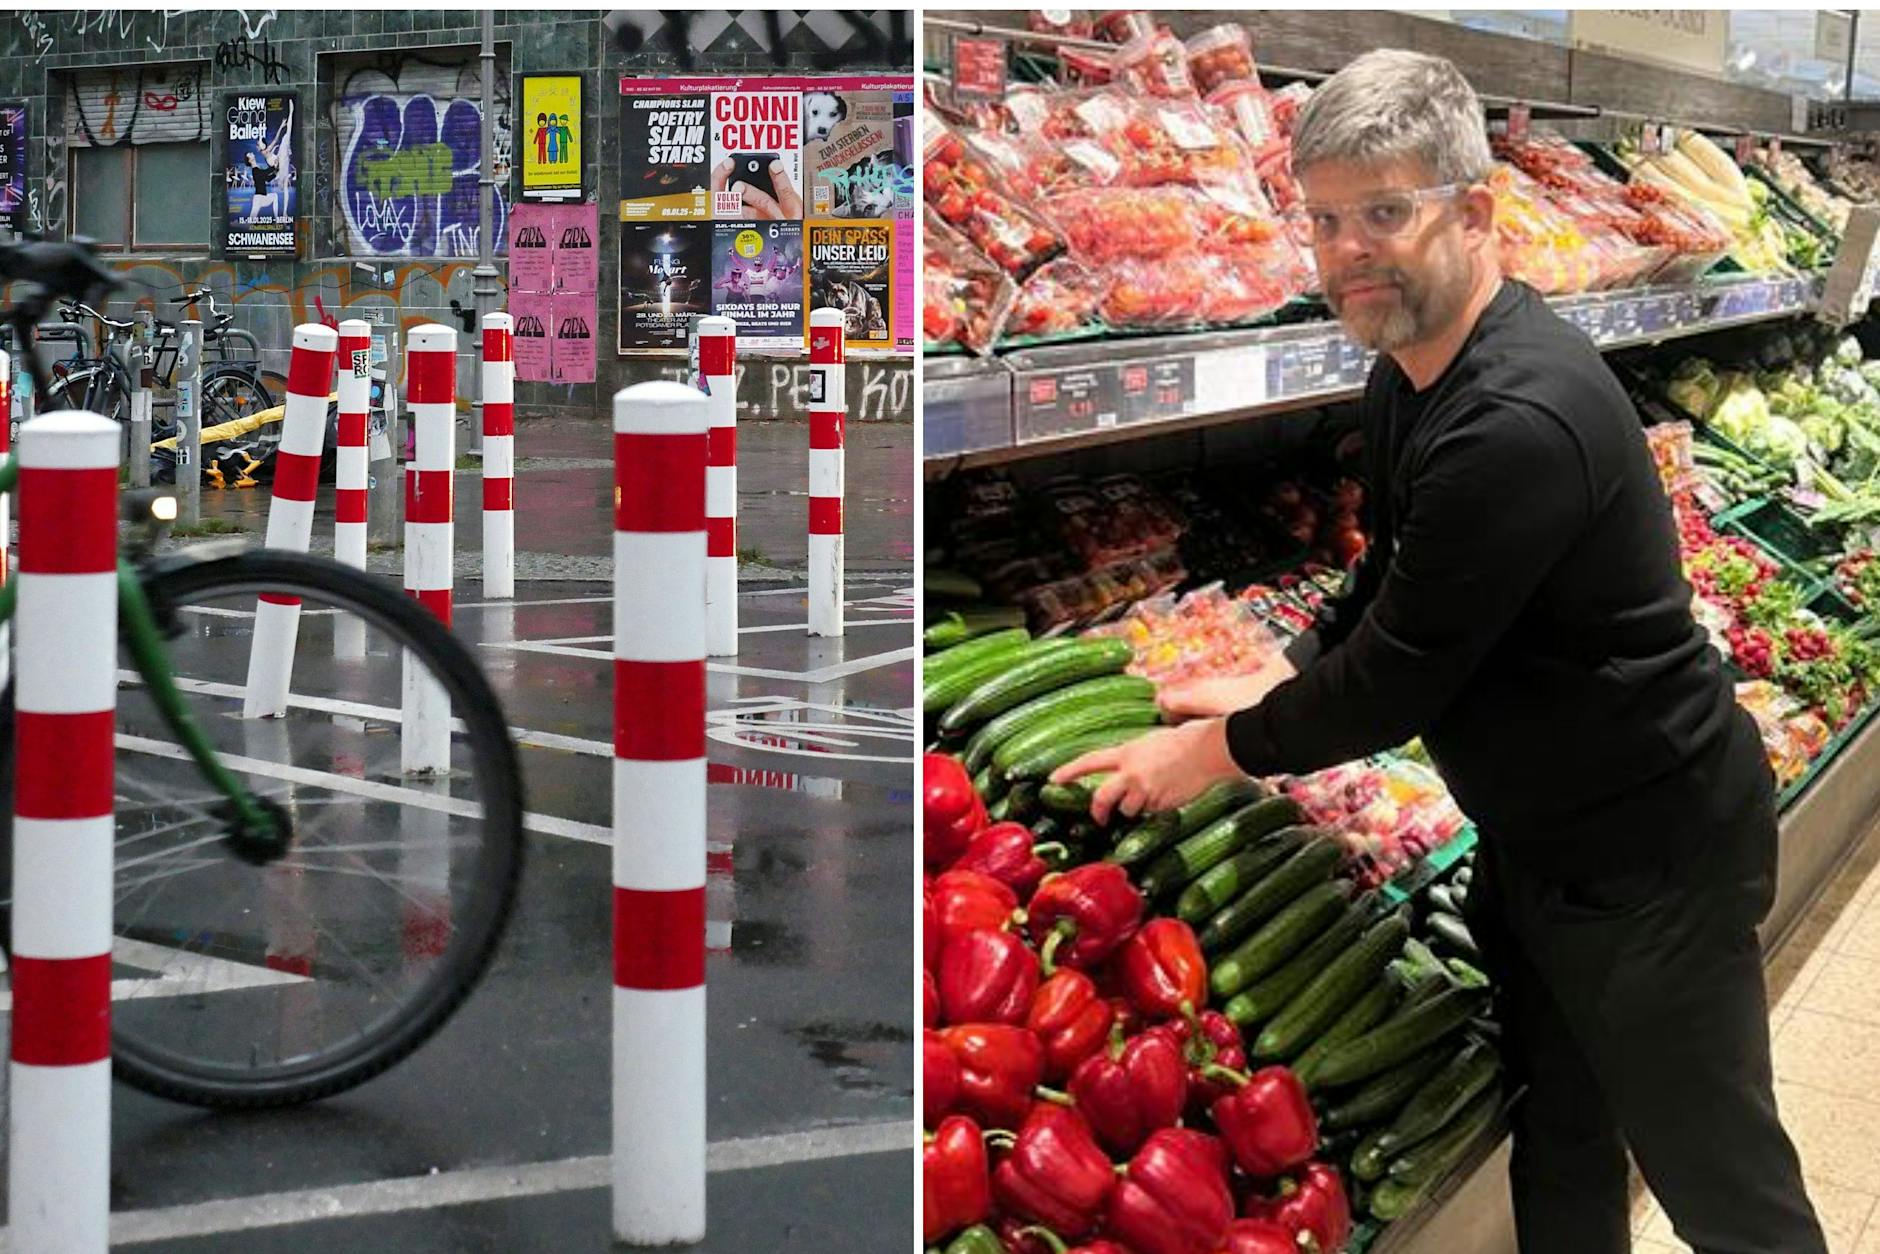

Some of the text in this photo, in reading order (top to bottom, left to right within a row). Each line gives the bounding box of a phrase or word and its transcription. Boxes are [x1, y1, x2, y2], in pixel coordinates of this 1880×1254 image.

[680, 83, 738, 92] Kulturplakatierung
[238, 97, 266, 110] Kiew
[633, 99, 706, 109] CHAMPIONS SLAM
[715, 95, 798, 122] CONNI
[226, 106, 267, 125] Grand
[648, 111, 705, 126] POETRY
[229, 124, 267, 140] Ballett
[648, 126, 706, 146] SLAM
[714, 124, 798, 150] & CLYDE
[818, 124, 870, 161] ZUM STERBEN
[648, 145, 706, 165] STARS
[717, 193, 740, 202] VOLKS
[227, 232, 295, 246] SCHWANENSEE
[813, 229, 887, 246] DEIN SPASS
[812, 245, 887, 261] UNSER LEID
[715, 303, 801, 311] SIXDAYS SIND NUR
